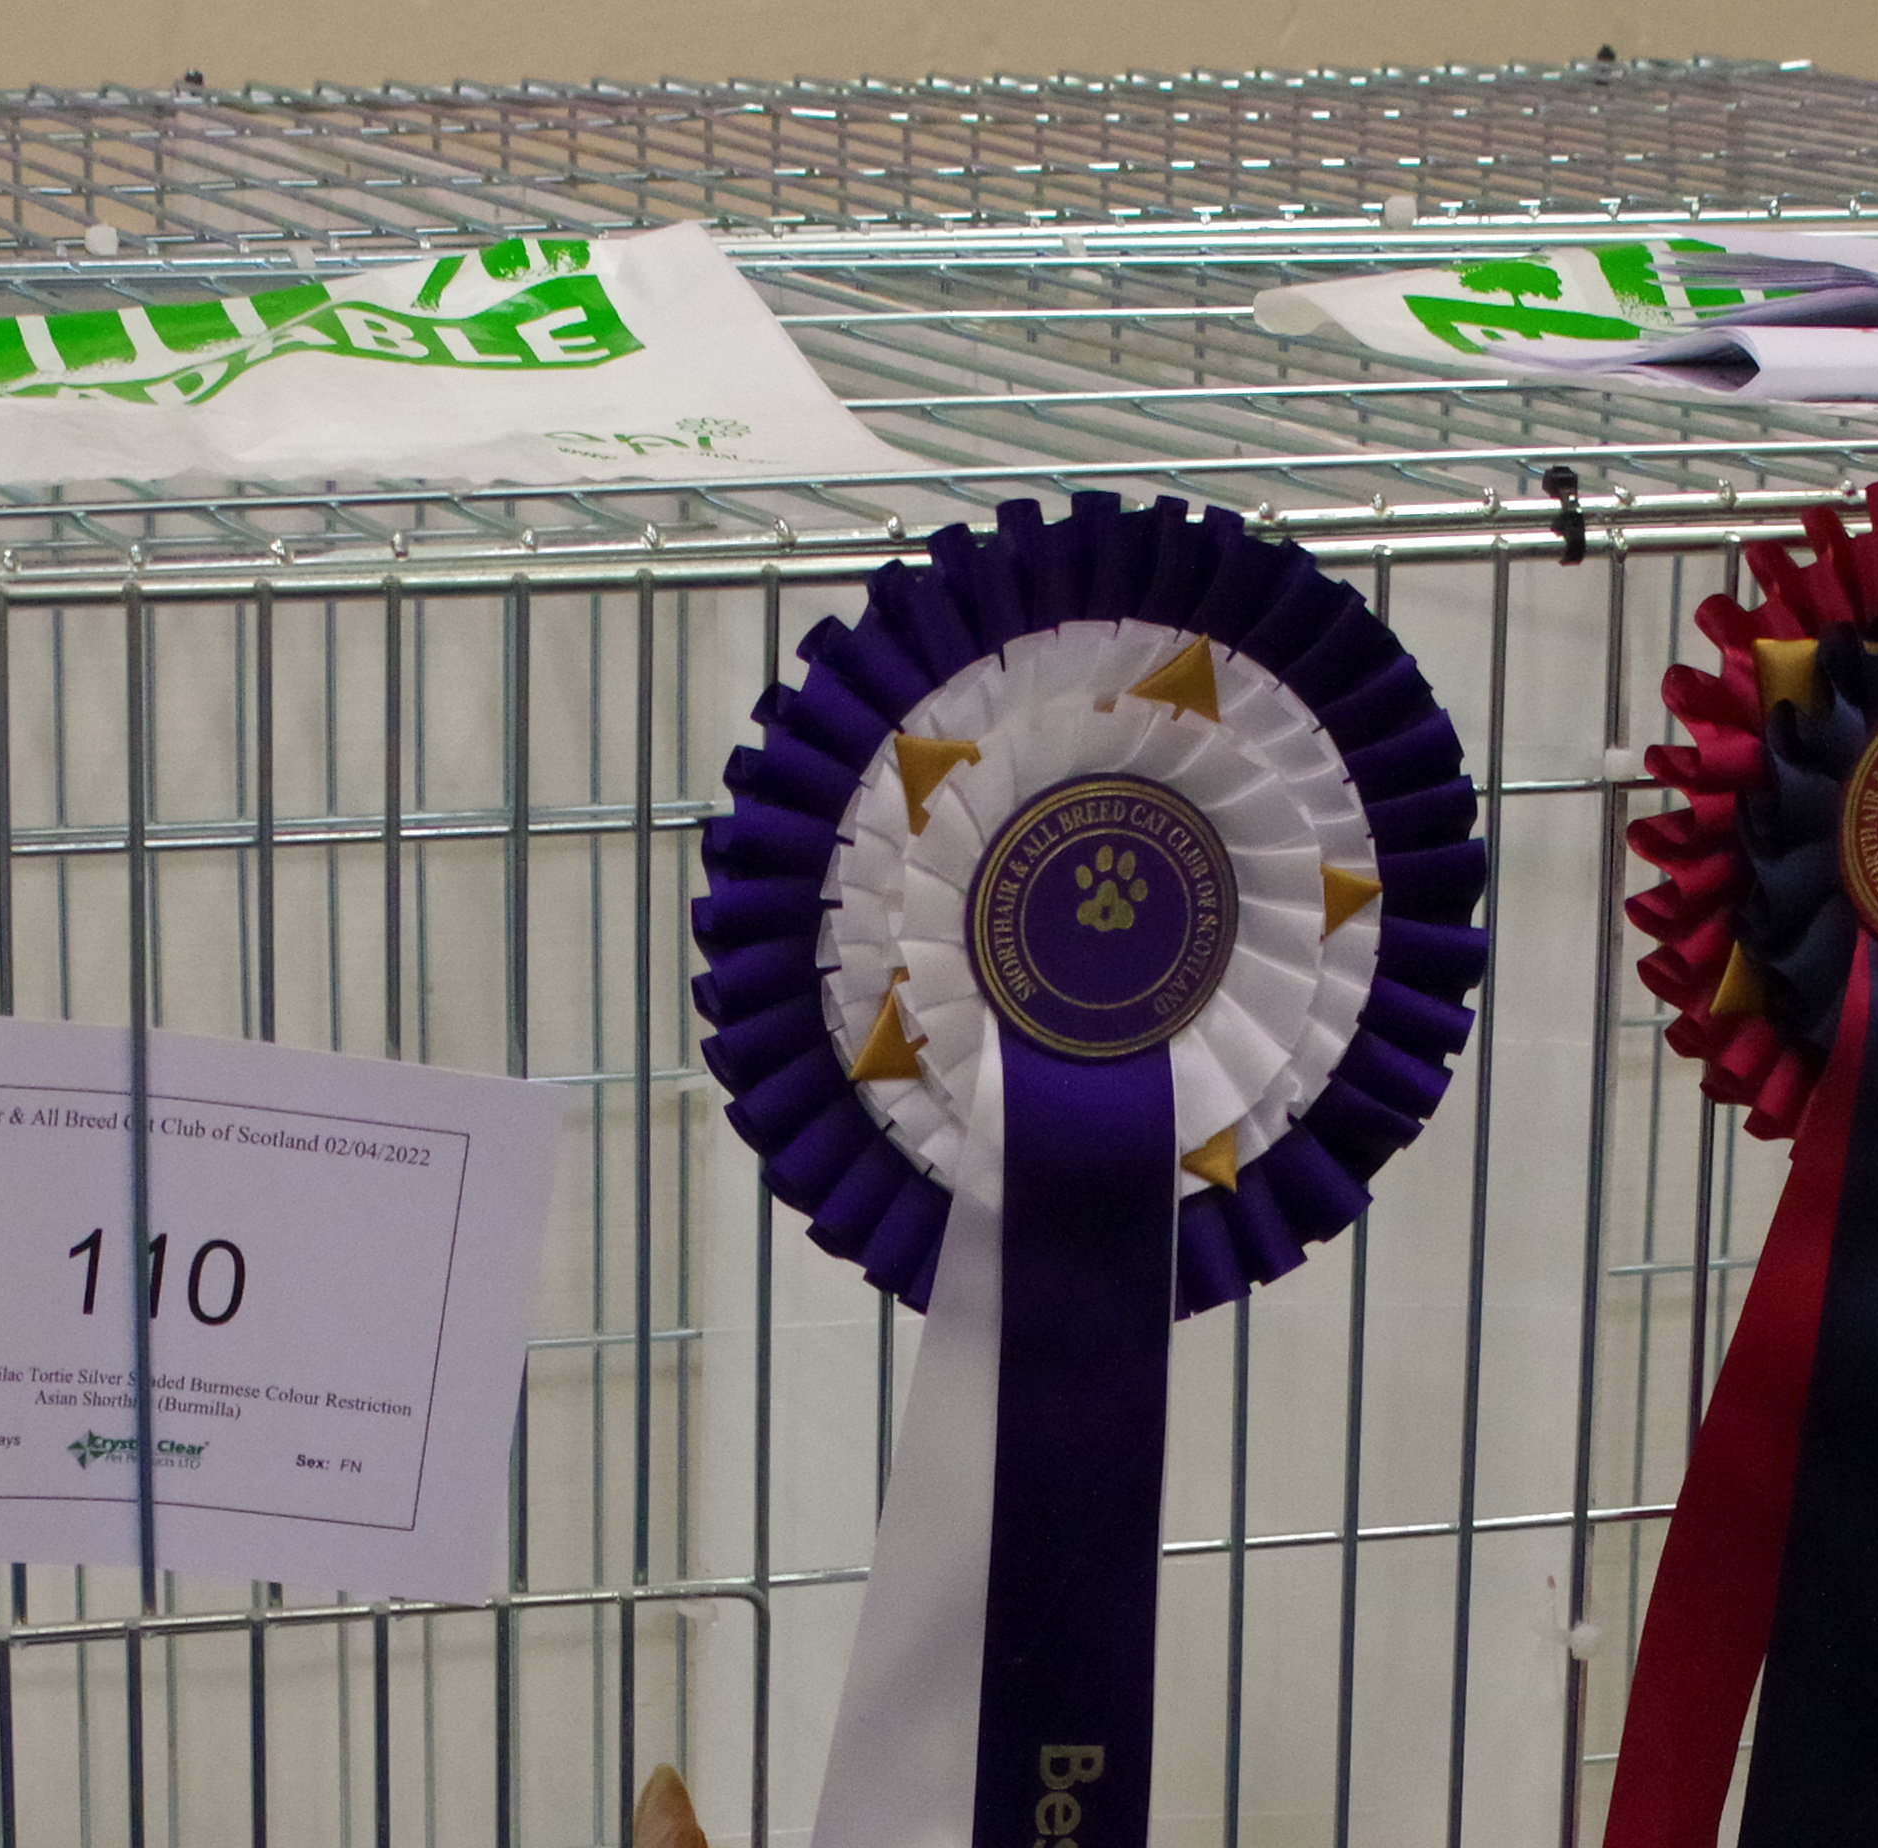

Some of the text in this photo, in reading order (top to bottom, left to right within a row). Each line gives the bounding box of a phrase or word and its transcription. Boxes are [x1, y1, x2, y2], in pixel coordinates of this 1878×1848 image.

[993, 801, 1219, 1016] SHORTHAIR & ALL BREED CAT CLUB OF SCOTLAND
[8, 1107, 24, 1125] &
[30, 1108, 60, 1127] All
[65, 1109, 118, 1130] Breed
[123, 1113, 155, 1133] Ct
[160, 1116, 206, 1138] Club
[211, 1123, 235, 1141] of
[237, 1125, 320, 1153] Scotland
[324, 1136, 432, 1167] 02/04/2022
[67, 1228, 246, 1327] 110
[28, 1367, 73, 1385] Tortie
[77, 1368, 123, 1387] Silver
[126, 1370, 186, 1391] Saded
[189, 1375, 261, 1400] Burmese
[265, 1384, 321, 1407] Colour
[325, 1390, 413, 1418] Restriction
[34, 1390, 78, 1406] Asian
[157, 1395, 242, 1421] (Burmilla)
[157, 1440, 205, 1456] Clear
[296, 1454, 363, 1473] Sex: FN
